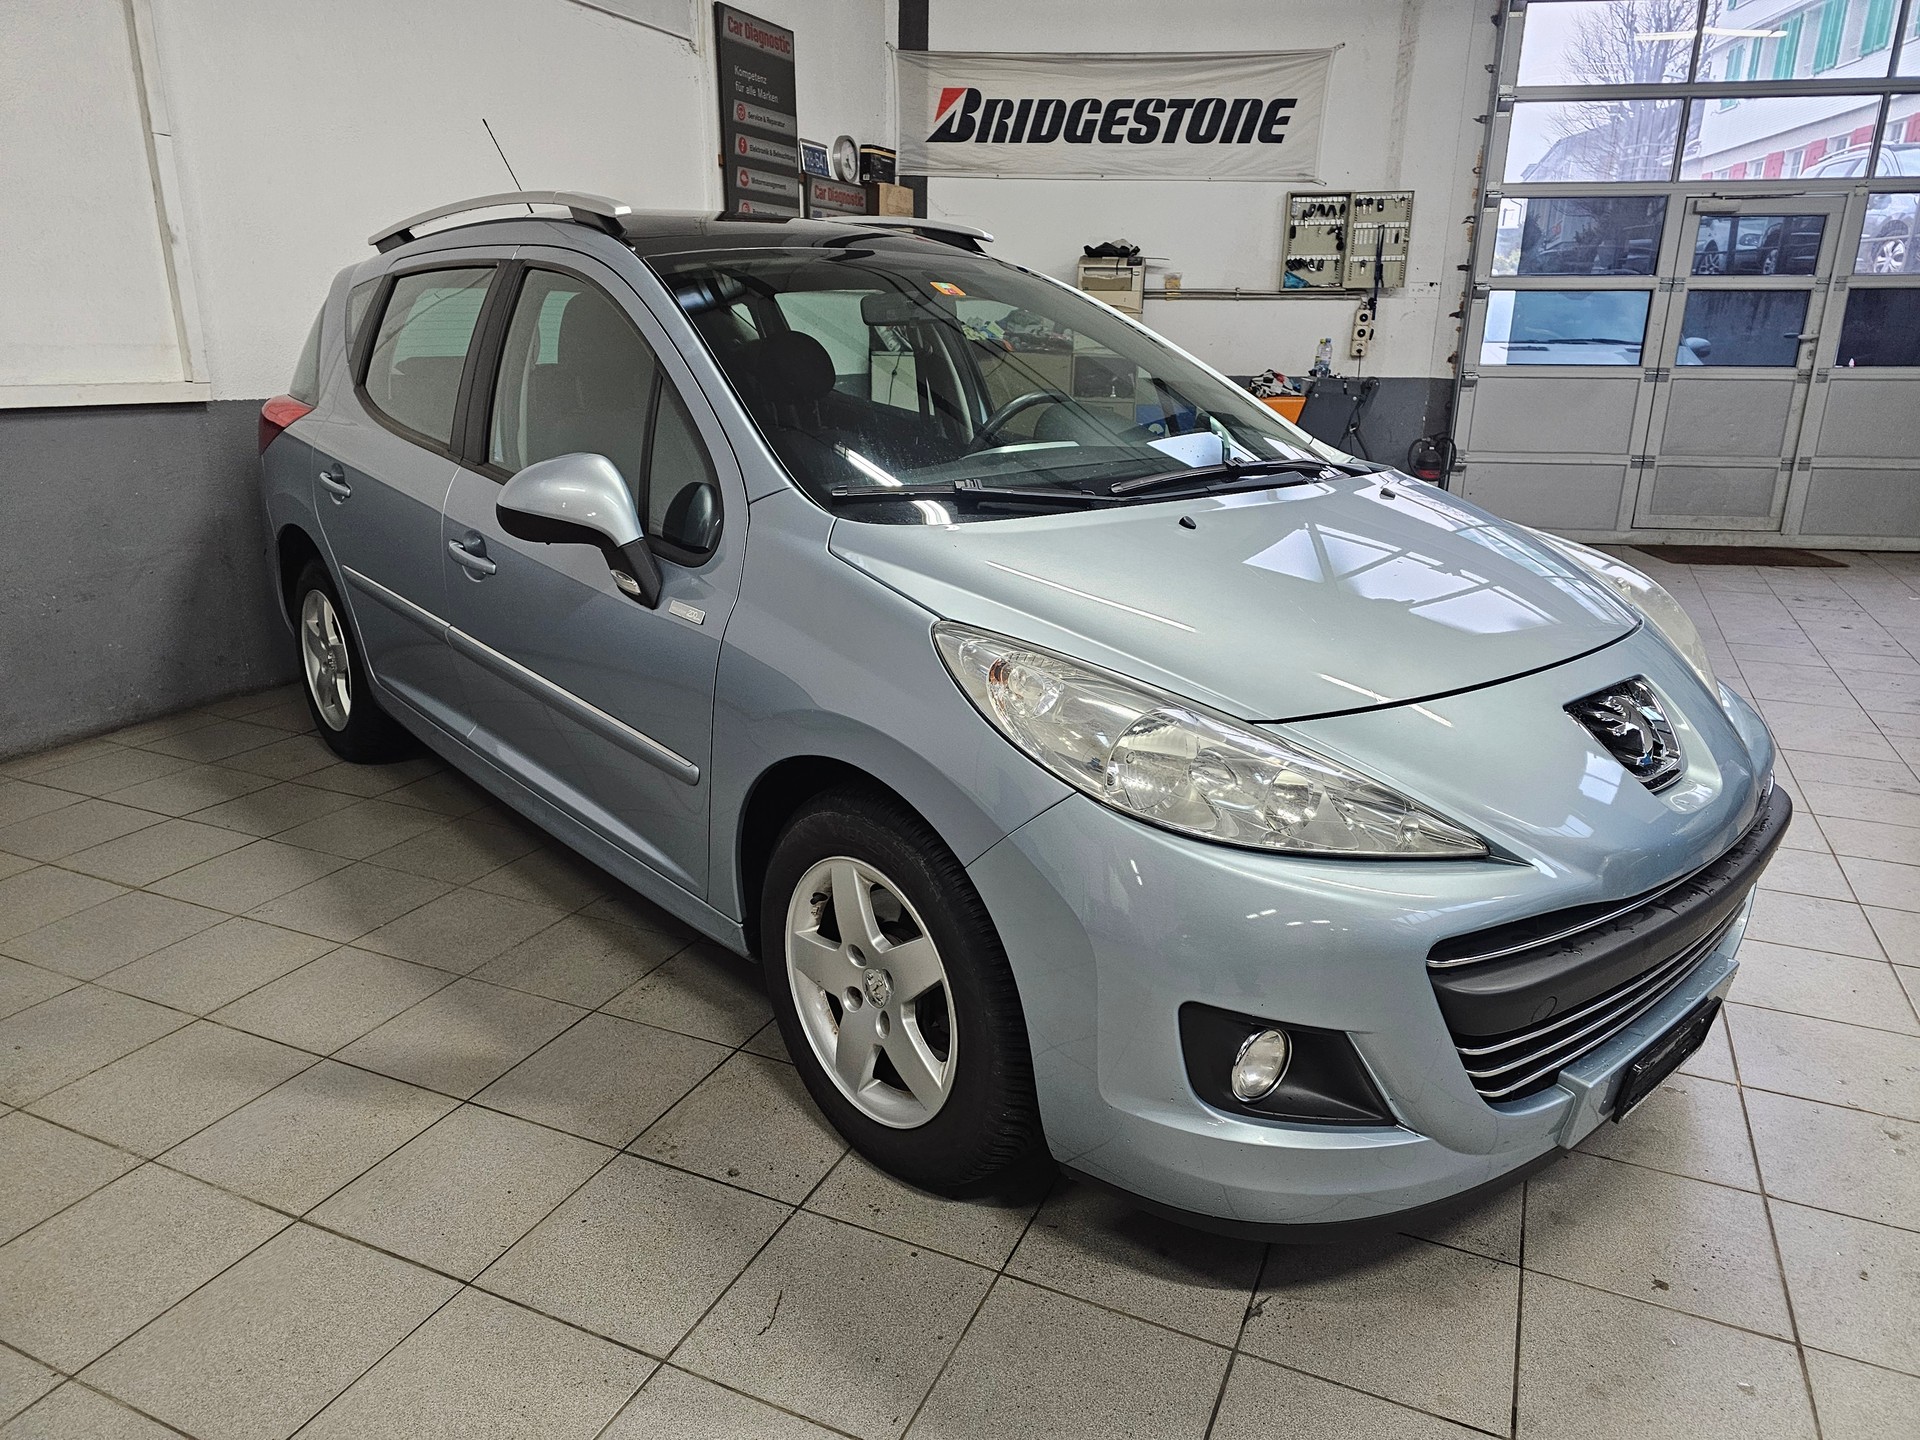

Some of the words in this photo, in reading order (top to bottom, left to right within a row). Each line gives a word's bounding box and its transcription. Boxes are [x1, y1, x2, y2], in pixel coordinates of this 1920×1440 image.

[727, 15, 743, 37] Car
[745, 21, 791, 54] Diagnostic
[734, 65, 767, 85] Kompetenz
[735, 81, 744, 92] für
[746, 85, 756, 97] alle
[757, 87, 779, 103] Marken
[925, 87, 1298, 144] BRIDGESTONE
[815, 184, 826, 200] Car
[828, 187, 864, 207] Diagnostic
